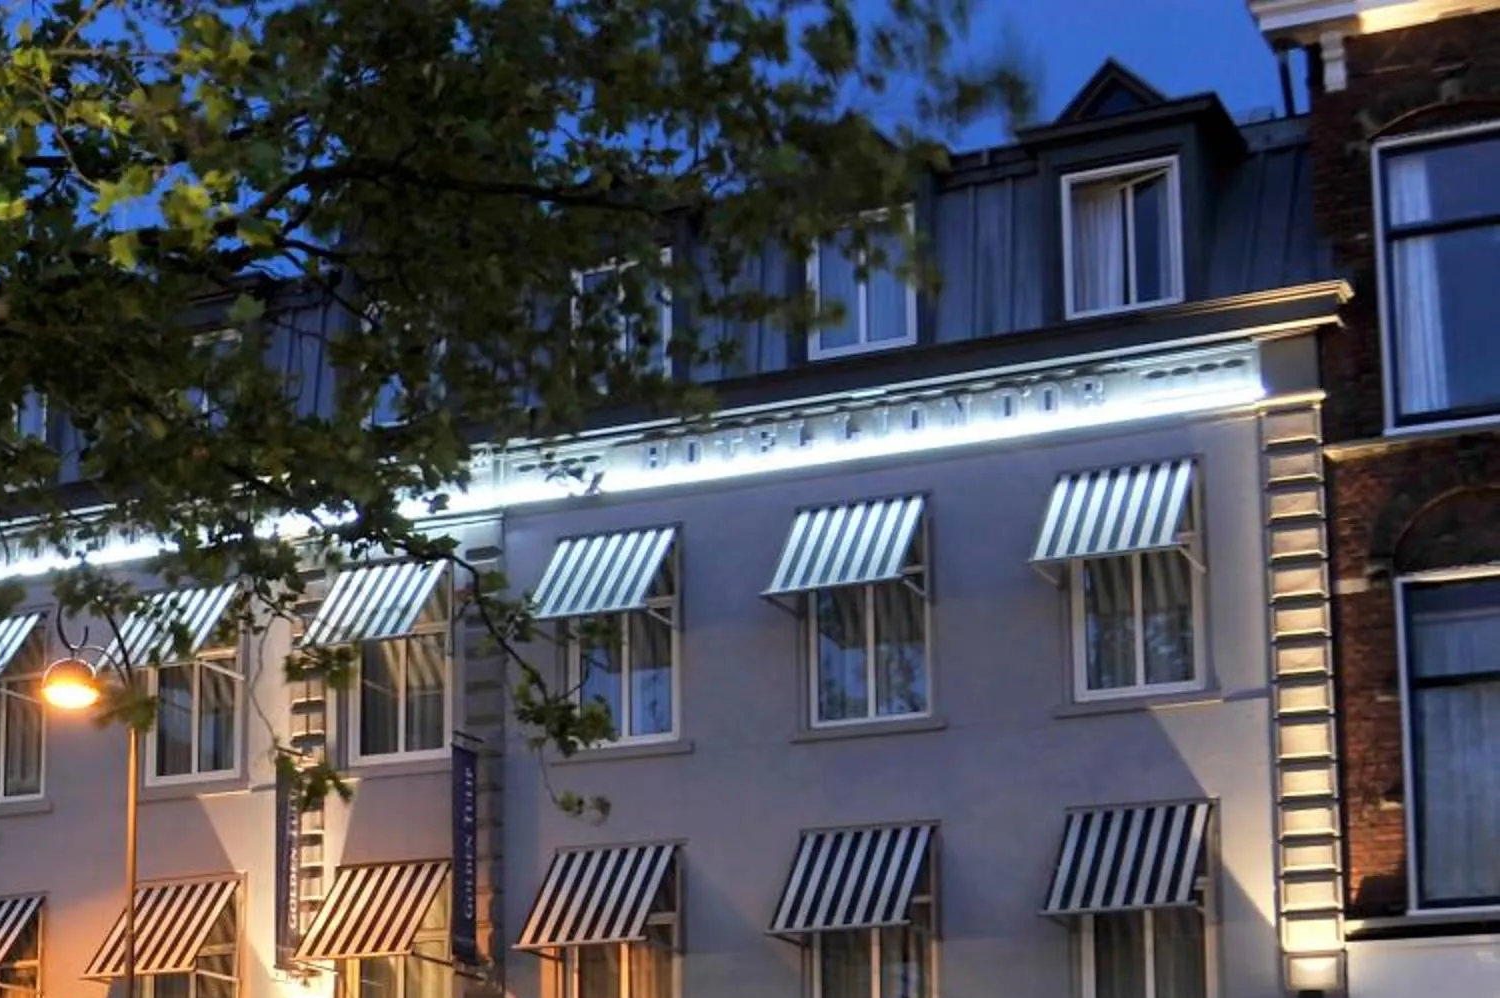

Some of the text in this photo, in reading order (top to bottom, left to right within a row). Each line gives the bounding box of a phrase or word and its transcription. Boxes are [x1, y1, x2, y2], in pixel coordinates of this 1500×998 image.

[288, 849, 298, 930] GOLDEN
[464, 767, 474, 920] GOLDEN TULIP
